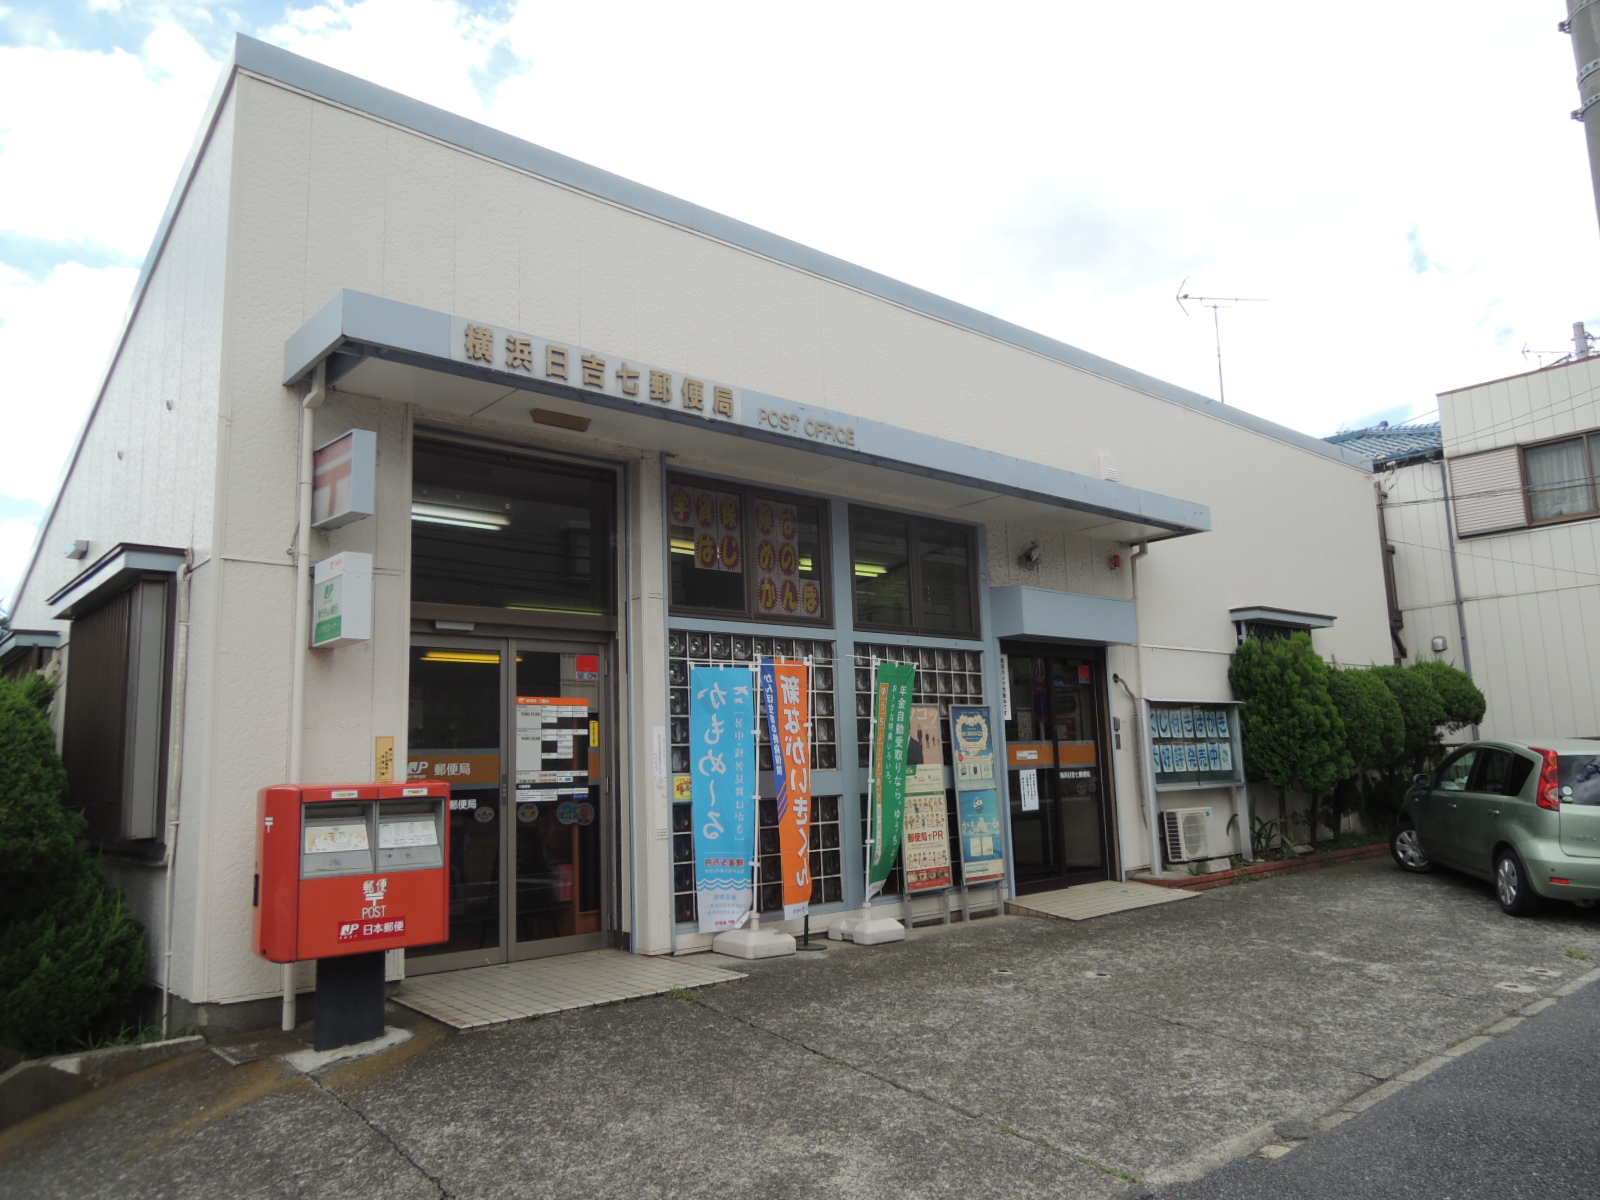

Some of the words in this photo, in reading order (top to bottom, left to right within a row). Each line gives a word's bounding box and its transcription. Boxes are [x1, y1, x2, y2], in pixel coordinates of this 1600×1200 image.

[464, 322, 734, 418] 横浜日吉七郵便局
[757, 406, 800, 433] POST
[803, 417, 856, 447] OFFICE
[434, 762, 471, 776] 郵便局
[907, 829, 944, 843] 郵便局でPR
[362, 878, 387, 895] 郵便
[361, 904, 387, 920] POST
[363, 920, 405, 936] 日本郵便
